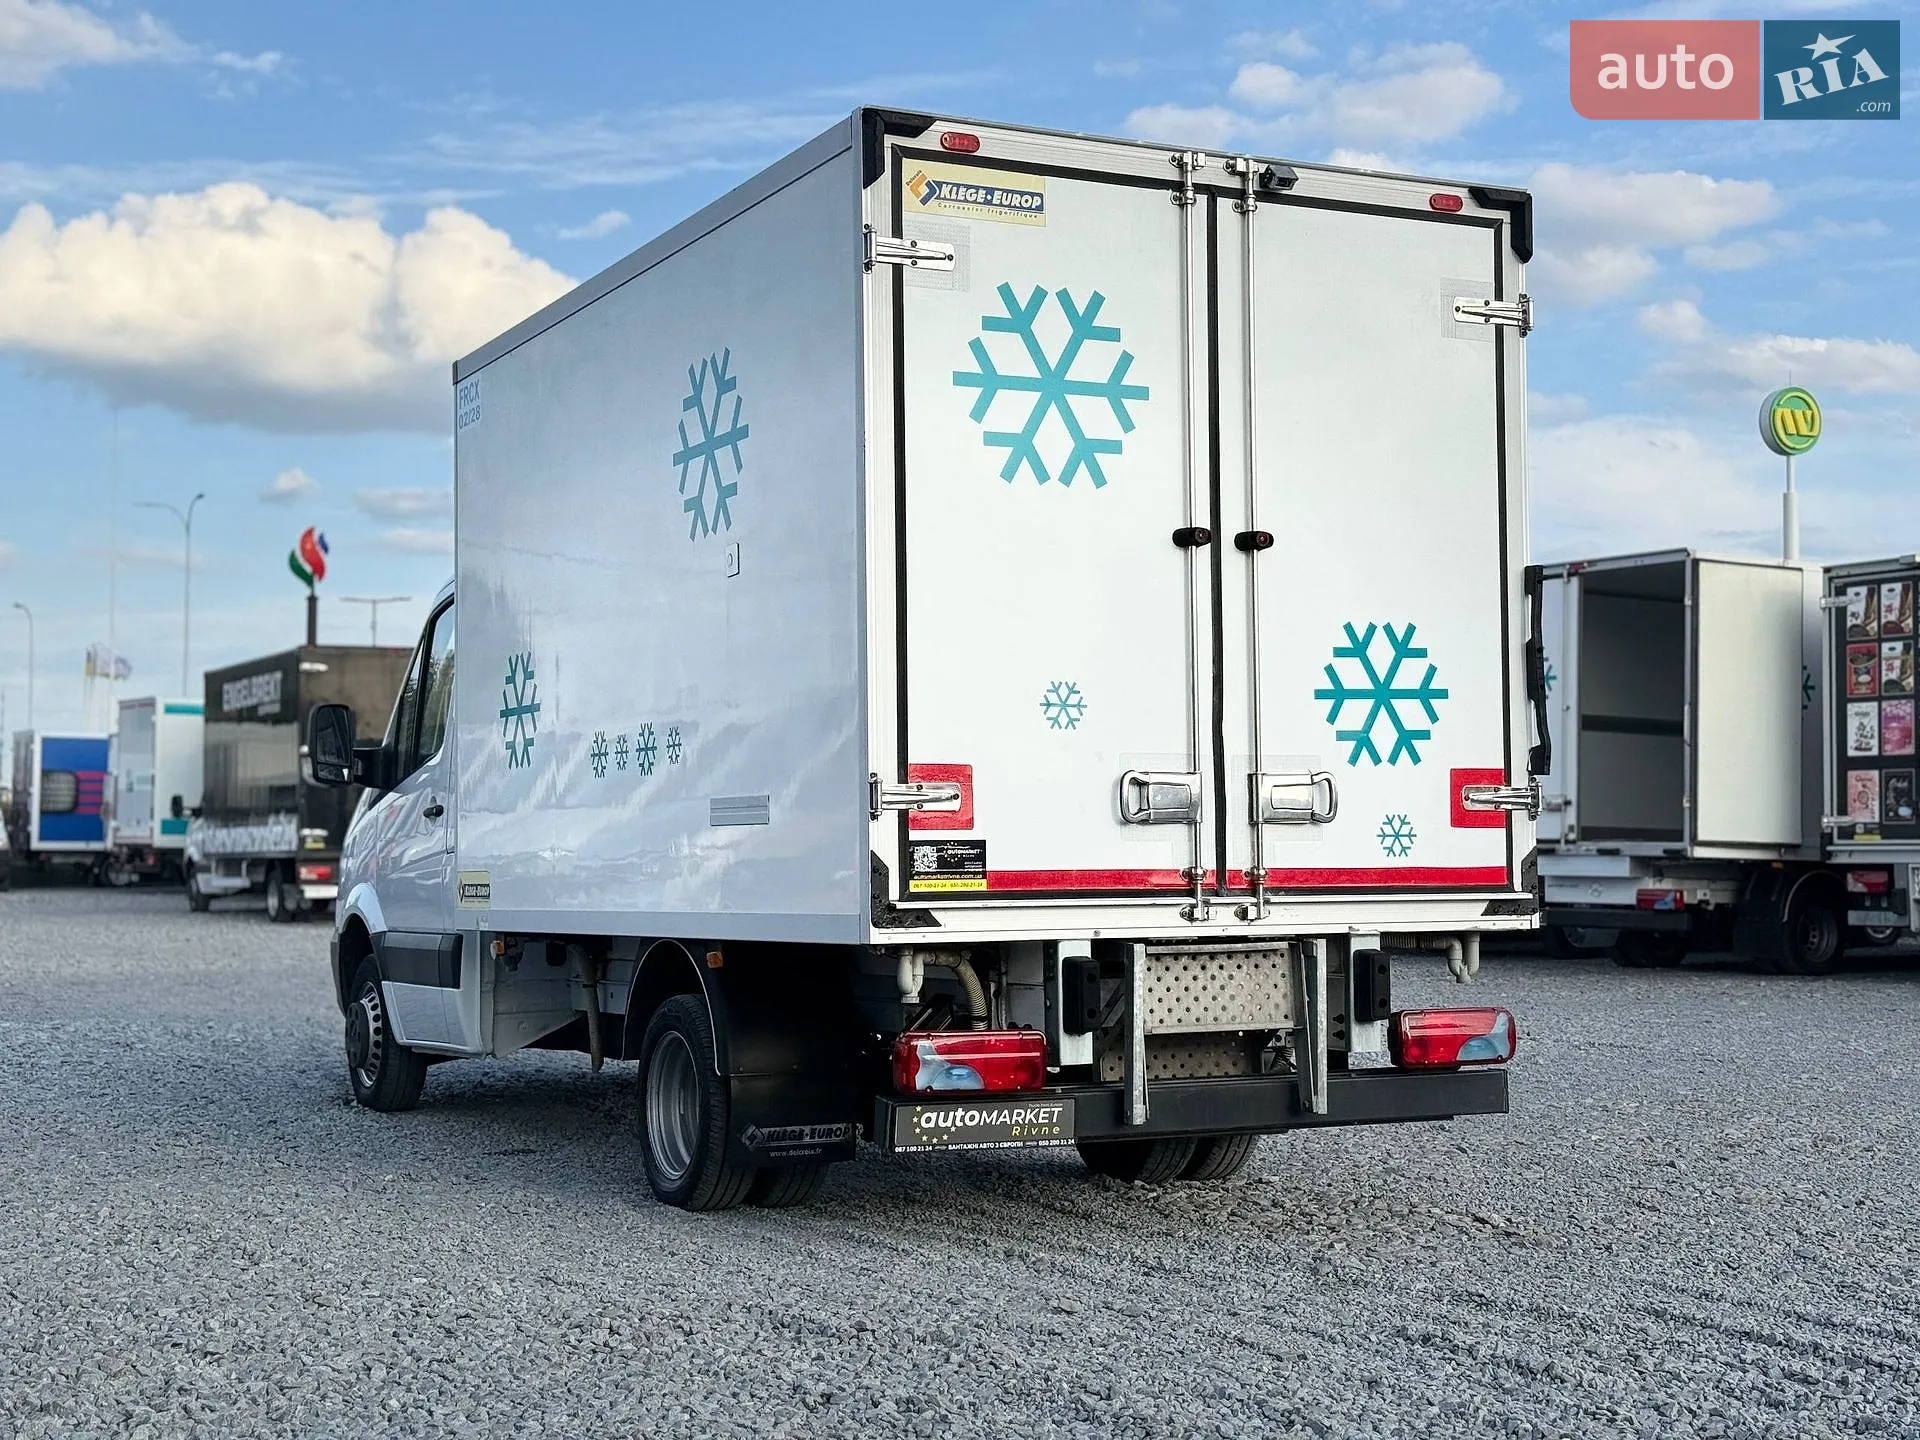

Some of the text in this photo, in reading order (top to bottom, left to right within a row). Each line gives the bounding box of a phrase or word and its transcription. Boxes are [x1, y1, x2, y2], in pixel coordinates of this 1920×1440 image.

[459, 378, 480, 410] FRCX
[458, 404, 481, 430] 02/28
[920, 1106, 1063, 1129] autoMARKET
[1011, 1124, 1061, 1136] Rivne
